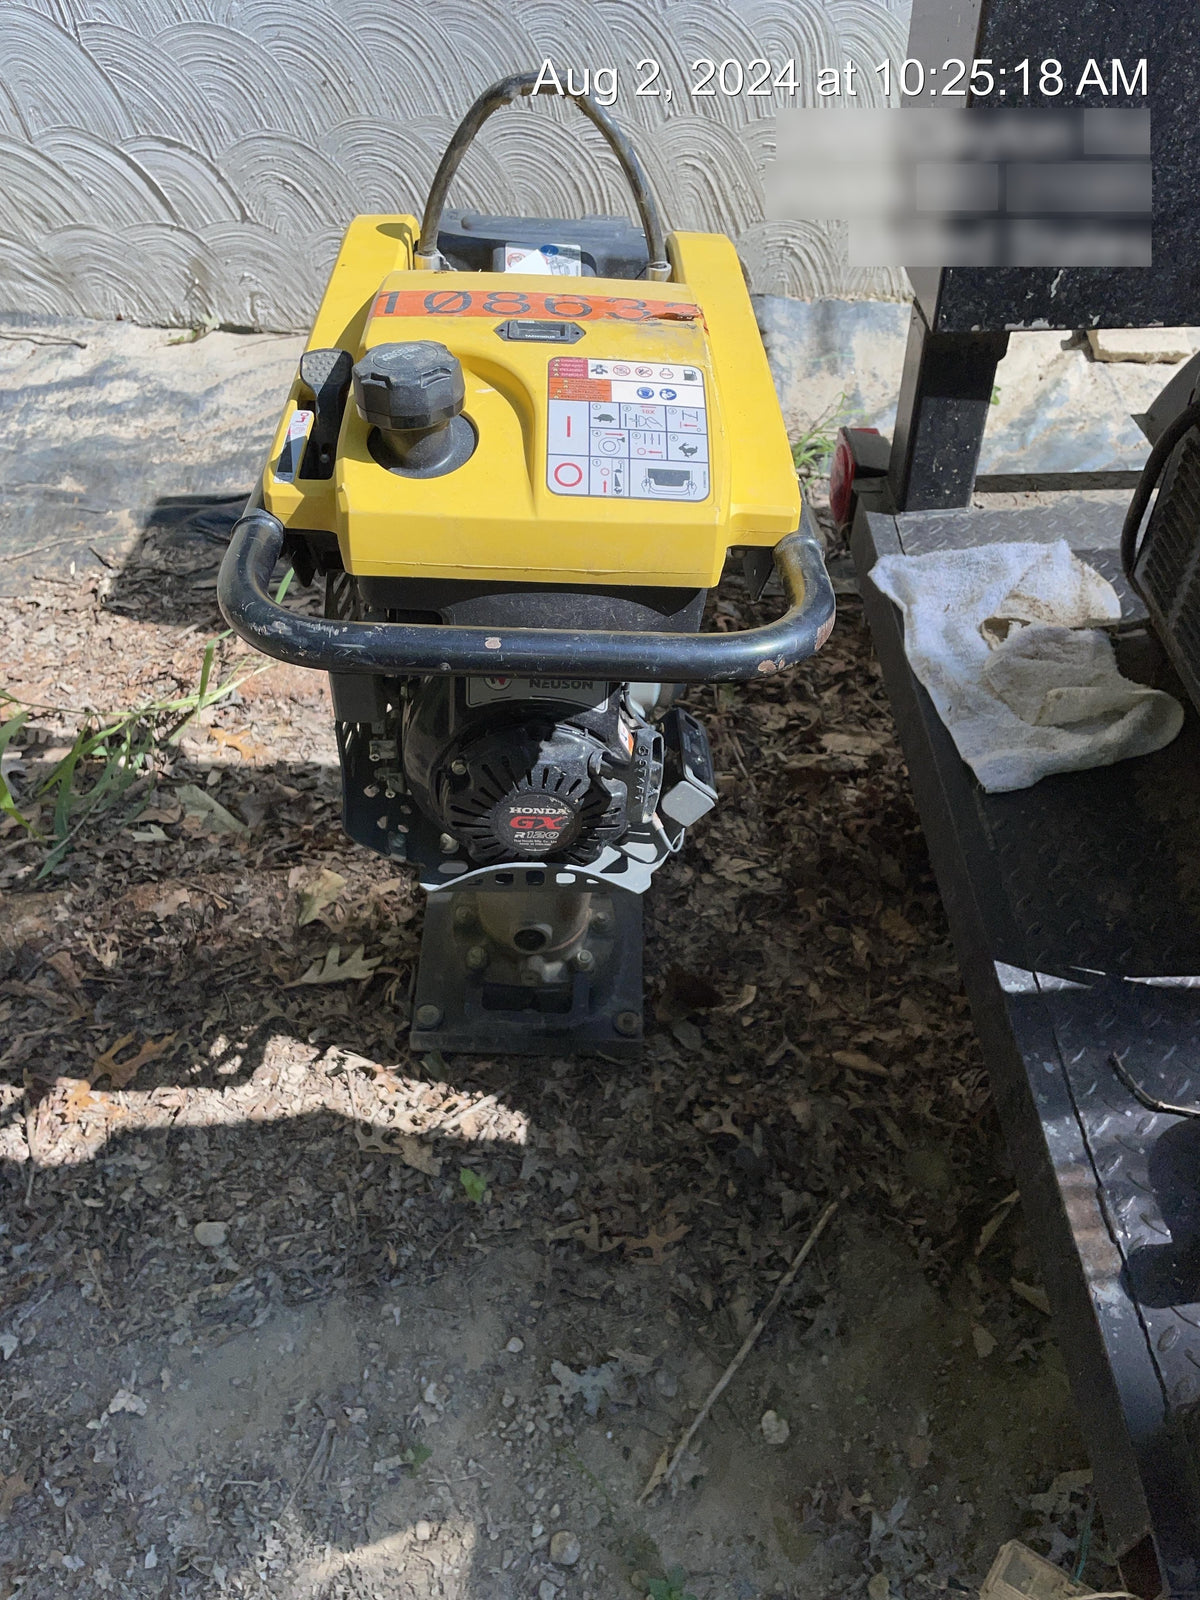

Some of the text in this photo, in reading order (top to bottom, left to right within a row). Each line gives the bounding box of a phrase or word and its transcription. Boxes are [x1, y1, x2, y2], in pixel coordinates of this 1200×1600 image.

[529, 678, 593, 690] NEUSON
[509, 806, 568, 815] HONDA
[510, 815, 566, 830] GX
